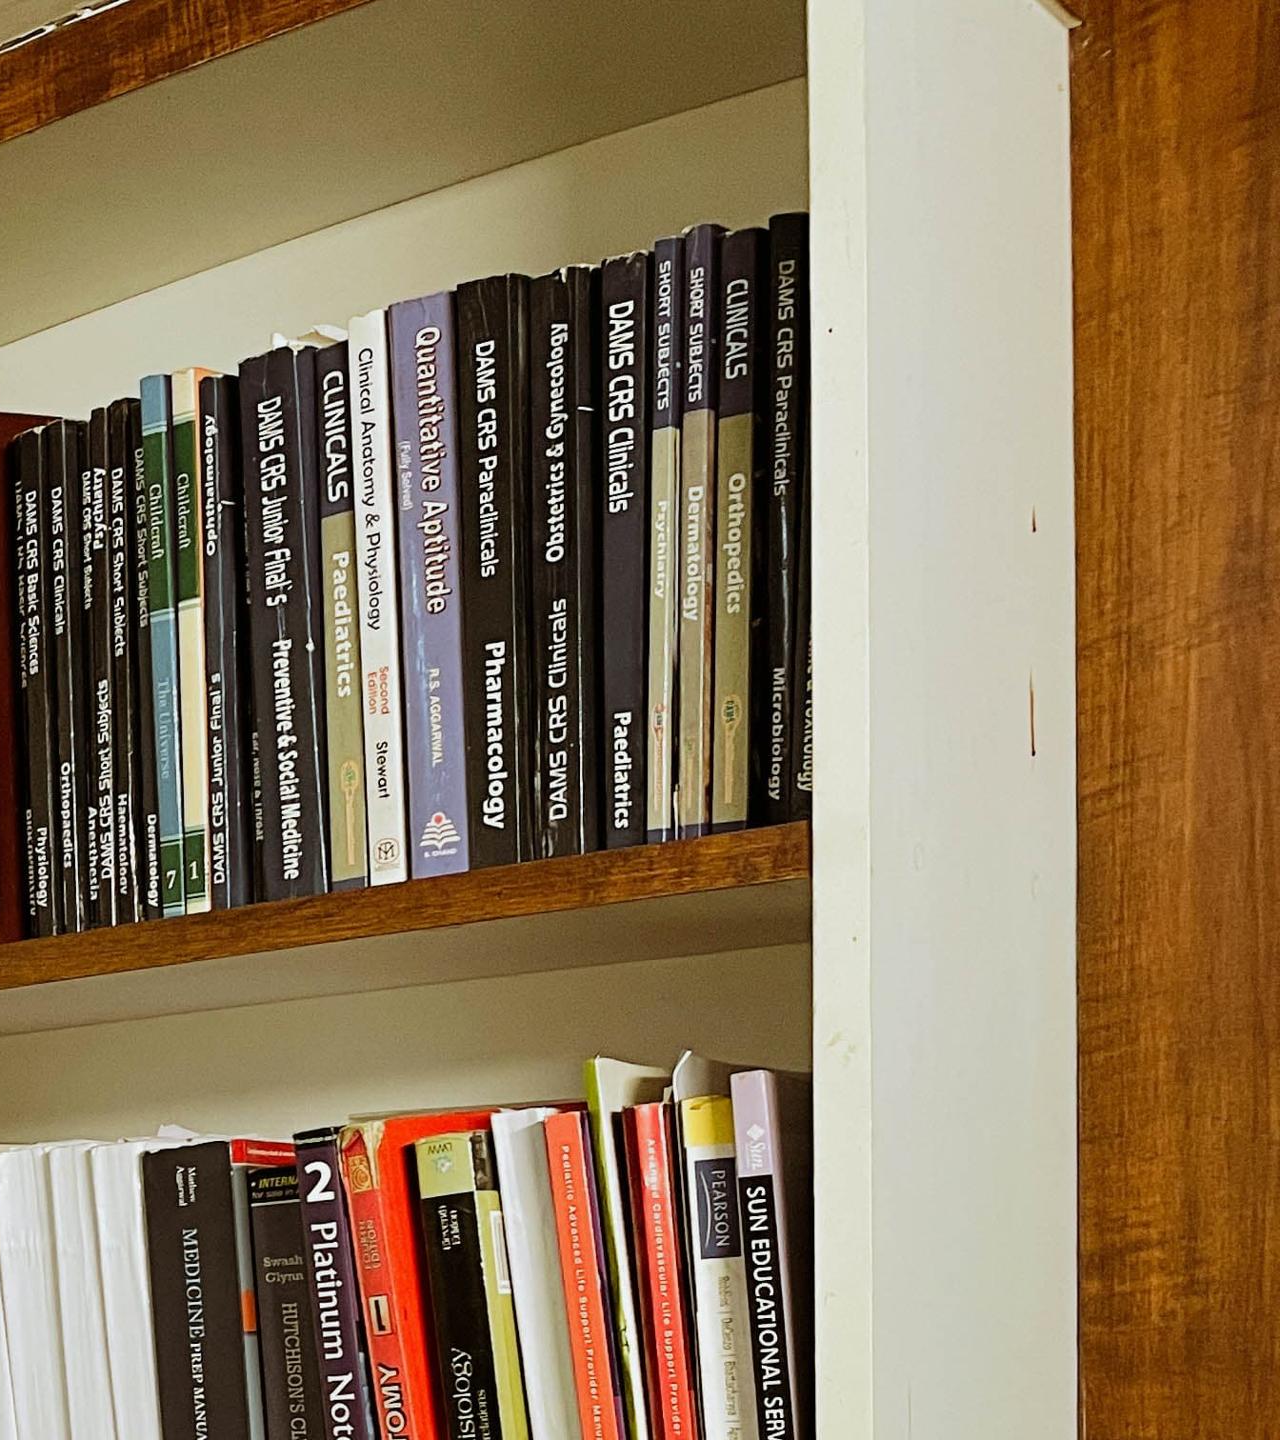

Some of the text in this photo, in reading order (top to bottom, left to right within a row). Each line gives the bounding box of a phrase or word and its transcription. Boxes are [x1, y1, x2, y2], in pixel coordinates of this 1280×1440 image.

[657, 260, 671, 411] SHORT SUBJECTS
[688, 266, 704, 403] SHORT SUBJECTS
[725, 279, 749, 380] CLINICALS
[323, 370, 349, 502] CLINICALS
[415, 326, 452, 615] Quantitative Aptitude
[476, 340, 500, 578] DAMS CRS Paraclinicals
[545, 323, 568, 563] Obstetrics & Gynecology
[608, 299, 635, 514] DAMS CRS Clinicals
[149, 484, 164, 560] Childcraft
[176, 473, 190, 549] Childcraft
[205, 414, 218, 556] Ophthalmology
[358, 348, 384, 630] Clinical Anatomy & Physiology
[683, 485, 704, 621] Dermatology
[332, 551, 356, 699] Paediatrics
[273, 639, 303, 880] Preventive & Social Medicine
[376, 741, 390, 799] Stewart
[483, 641, 508, 829] Pharmacology
[548, 598, 568, 820] DAMS CRS Clinicals
[613, 711, 633, 829] Paediatrics
[166, 870, 176, 889] 7
[189, 861, 198, 879] 1
[304, 1161, 335, 1204] 2
[568, 1205, 582, 1264] Advanced
[711, 1169, 730, 1248] PEARSON
[746, 1186, 767, 1233] SUN
[182, 1228, 205, 1338] MEDICINE
[310, 1222, 345, 1361] Platinum
[751, 1239, 781, 1390] EDUCATIONAL
[190, 1342, 205, 1386] PREP
